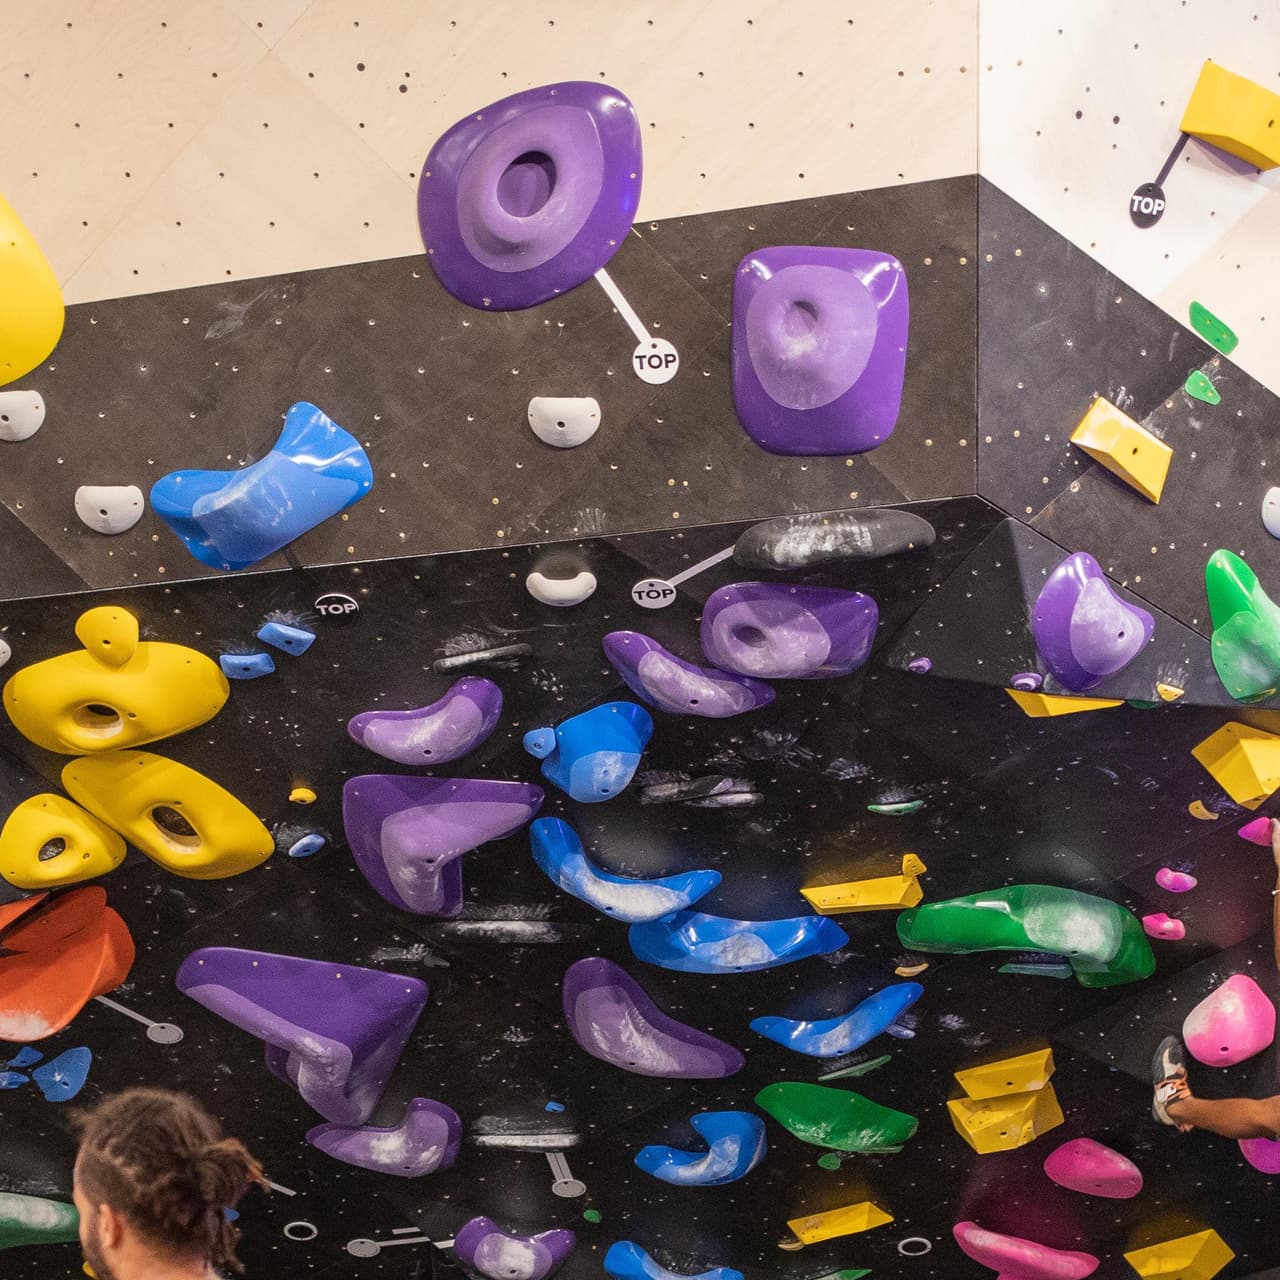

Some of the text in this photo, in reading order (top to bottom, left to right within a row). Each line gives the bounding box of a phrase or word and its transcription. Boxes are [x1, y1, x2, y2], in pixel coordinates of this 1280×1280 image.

[1132, 195, 1165, 215] TOP
[635, 354, 676, 369] TOP
[633, 588, 674, 600] TOP
[316, 603, 356, 615] TOP
